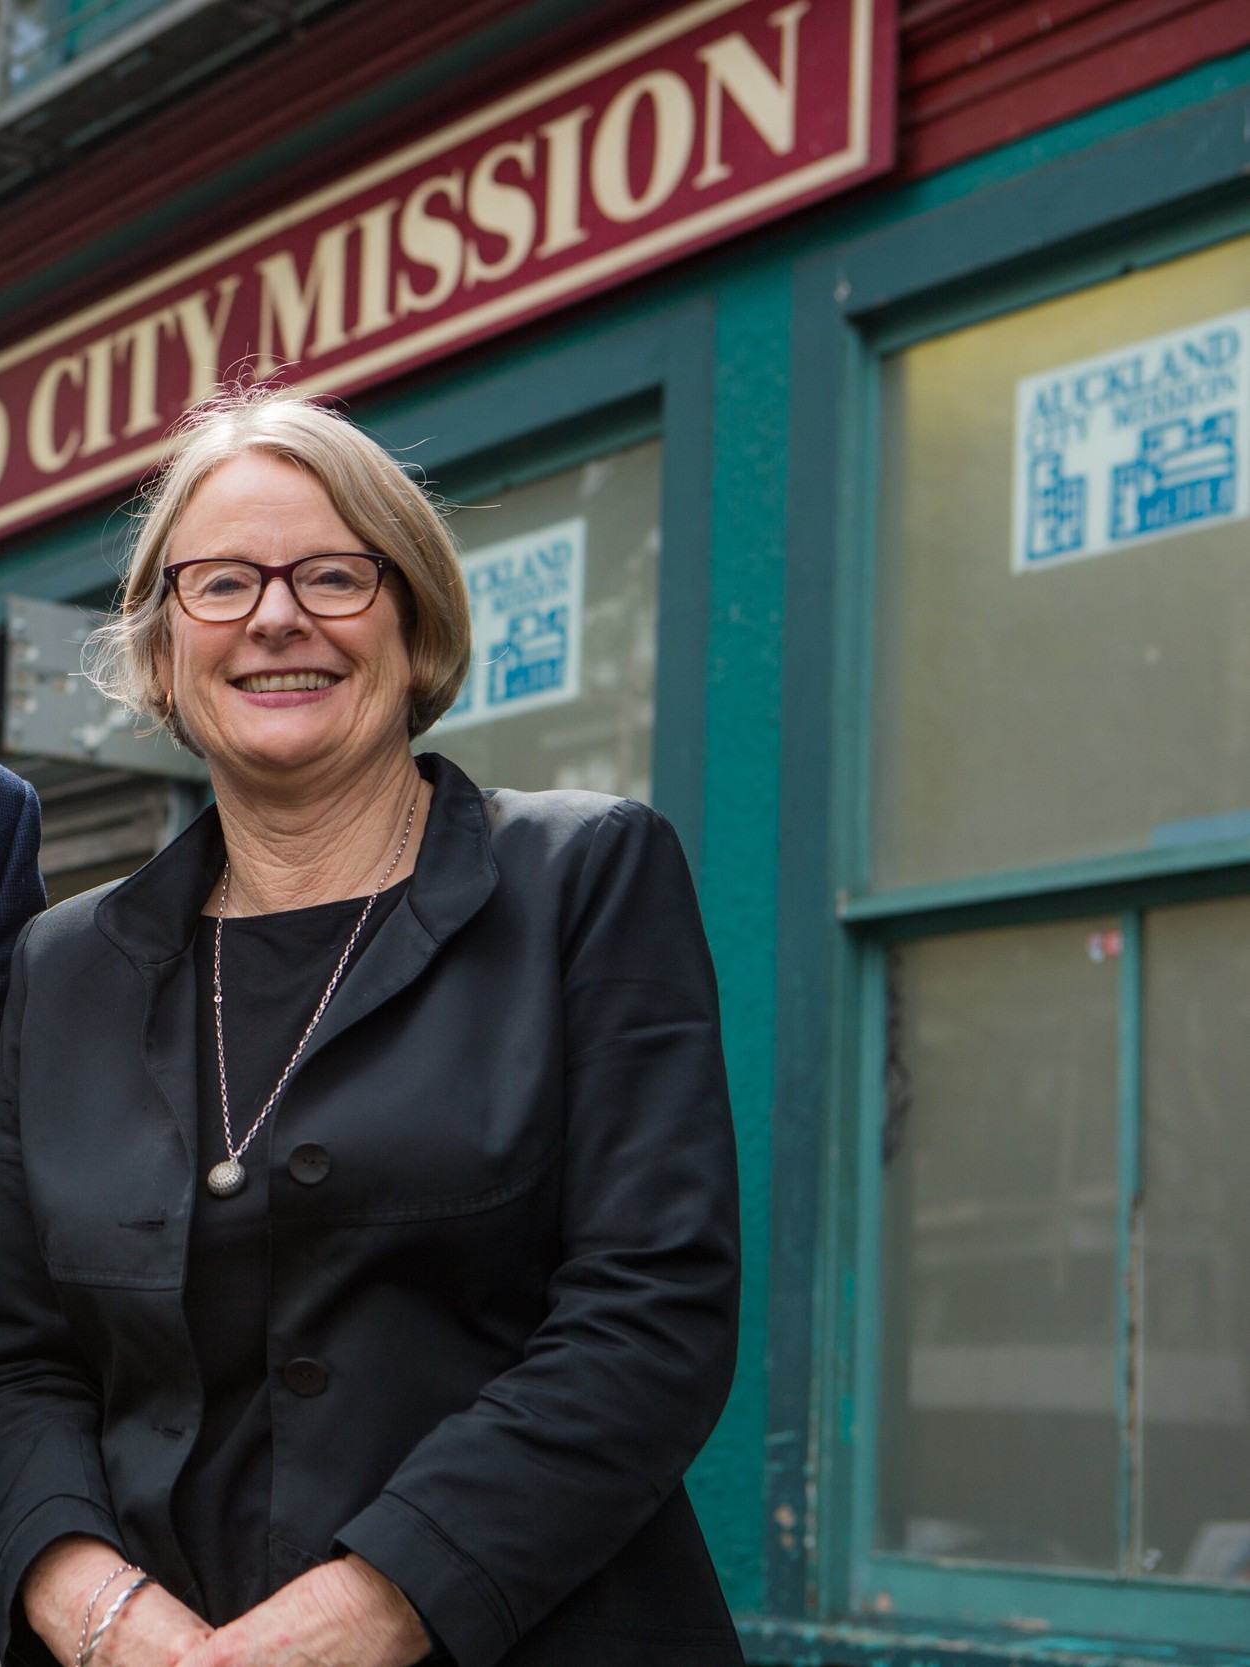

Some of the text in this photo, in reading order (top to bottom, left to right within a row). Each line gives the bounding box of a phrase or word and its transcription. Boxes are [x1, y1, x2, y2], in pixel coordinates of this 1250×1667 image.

[27, 274, 242, 474] CITY
[255, 1, 809, 382] MISSION
[1034, 326, 1240, 416] AUCKLAND
[1027, 411, 1087, 452] CITY
